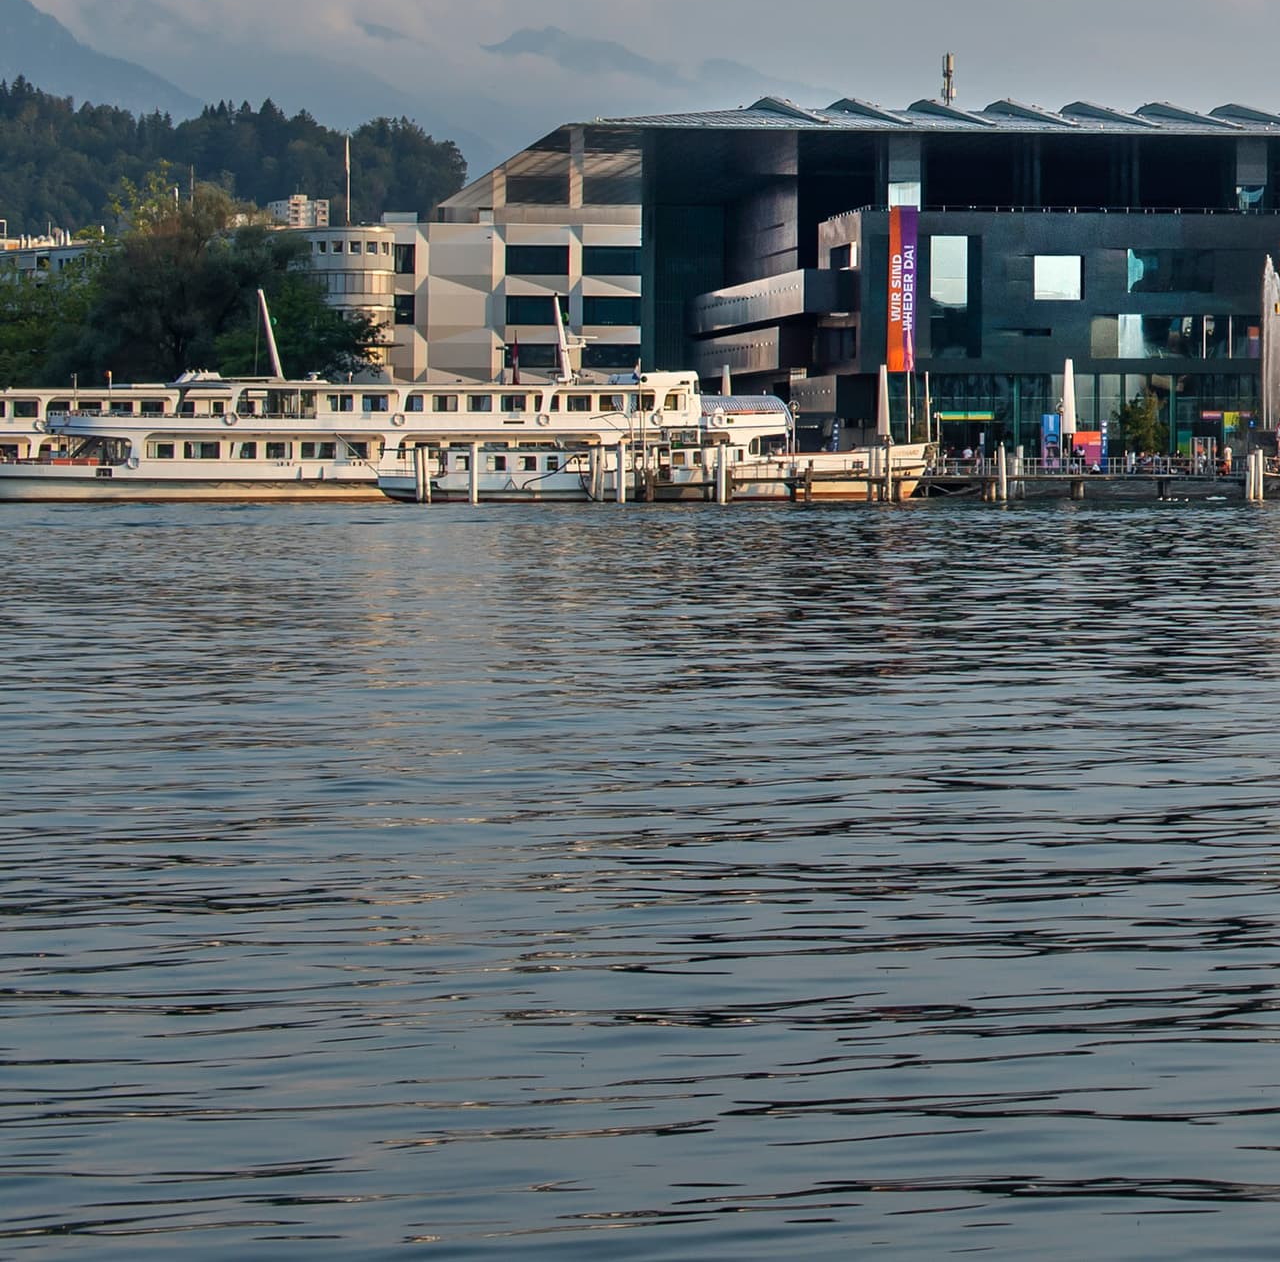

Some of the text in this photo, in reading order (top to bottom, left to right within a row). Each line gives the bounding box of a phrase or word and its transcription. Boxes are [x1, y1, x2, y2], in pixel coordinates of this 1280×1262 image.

[890, 254, 902, 323] WIR SIND
[902, 245, 914, 331] WIEDER DA!
